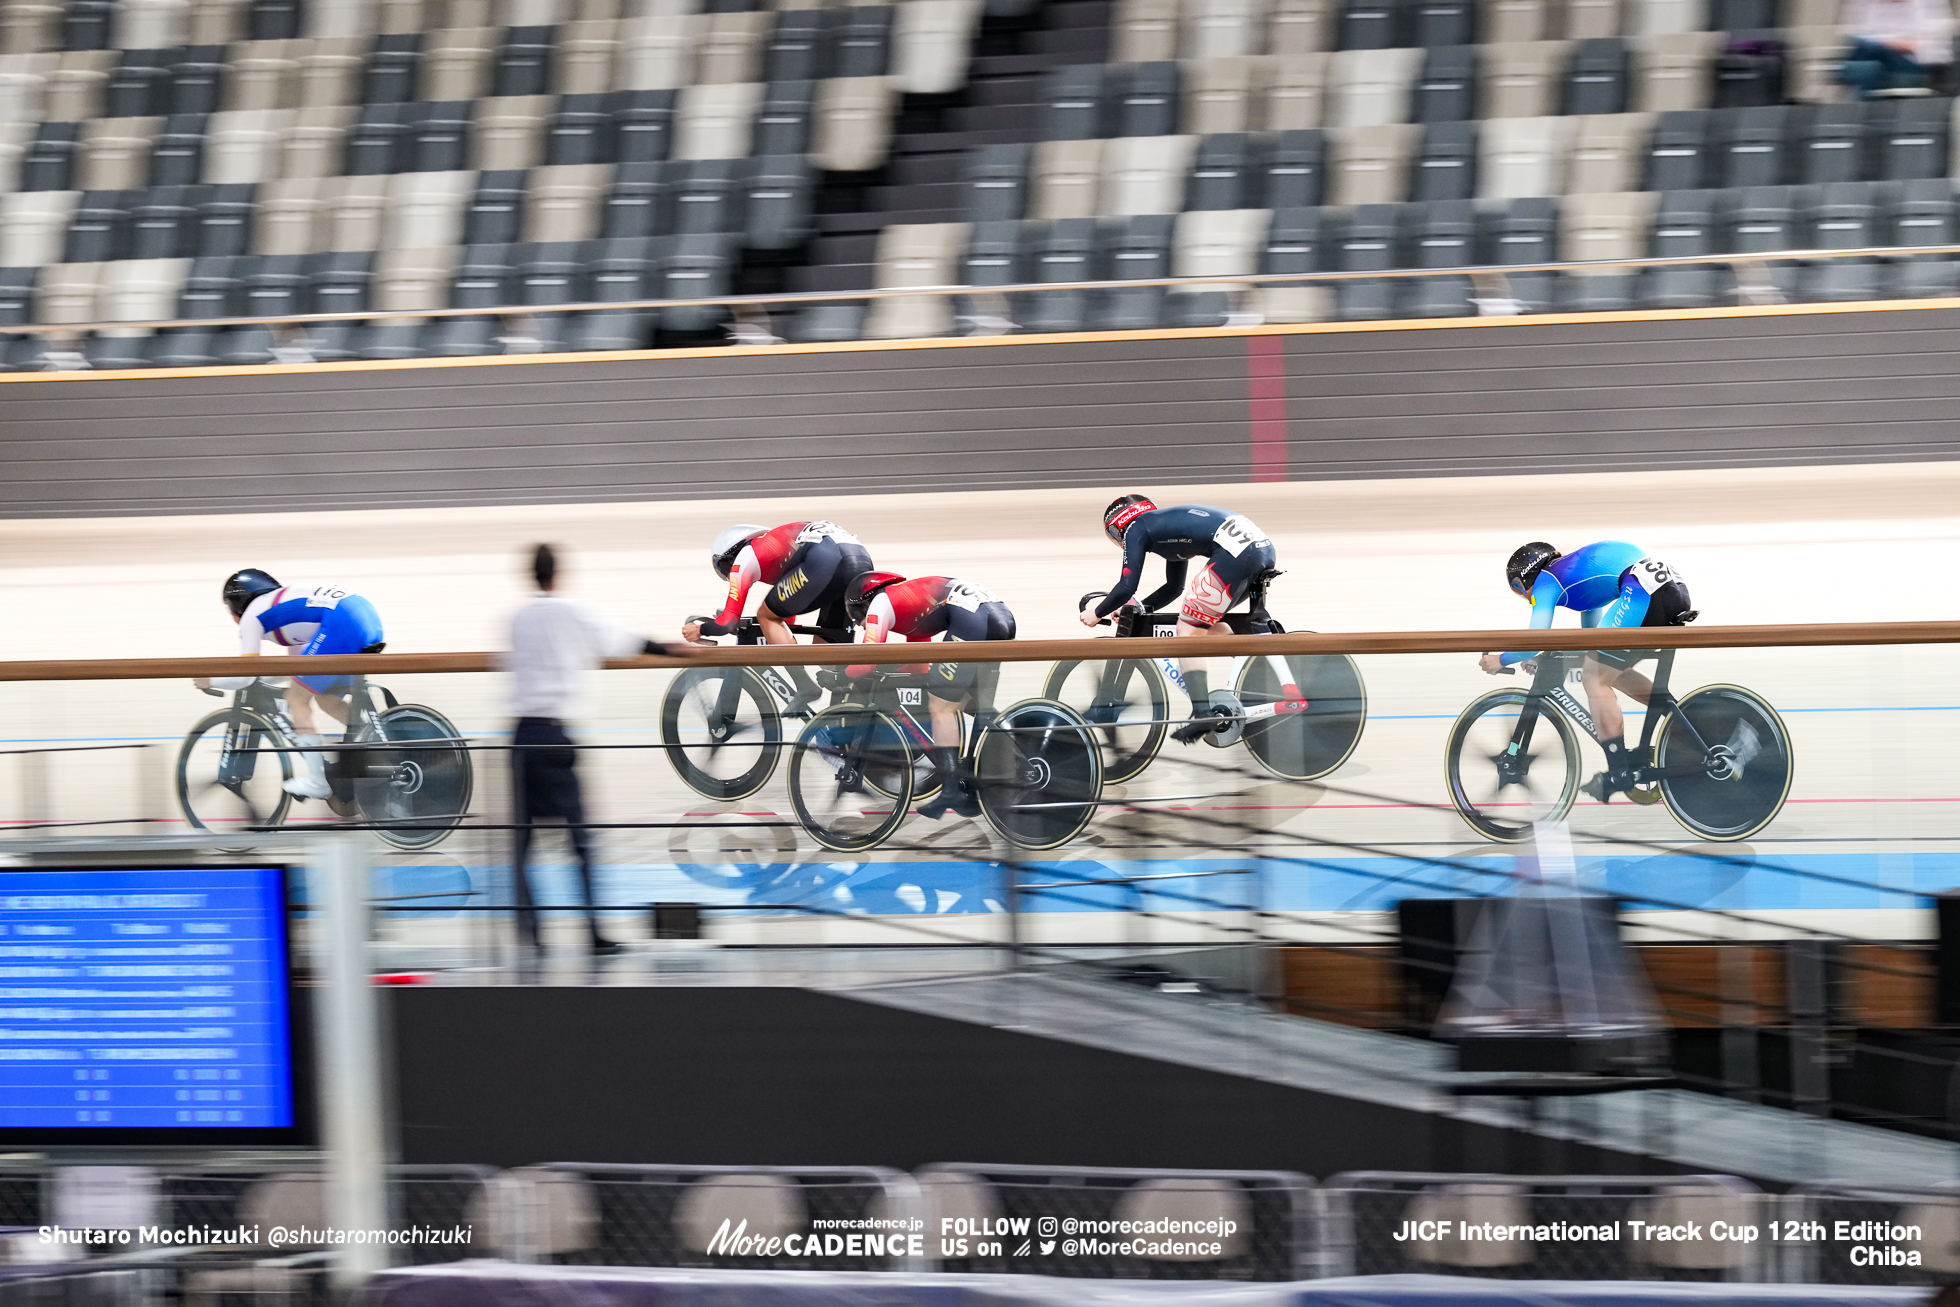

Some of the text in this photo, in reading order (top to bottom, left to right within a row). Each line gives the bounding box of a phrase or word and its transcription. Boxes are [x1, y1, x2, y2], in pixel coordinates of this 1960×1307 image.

[1117, 504, 1152, 527] Kabuto
[1520, 552, 1549, 578] Kabuto
[729, 577, 739, 602] ANTA
[777, 567, 809, 602] CHINA
[900, 691, 920, 703] 104
